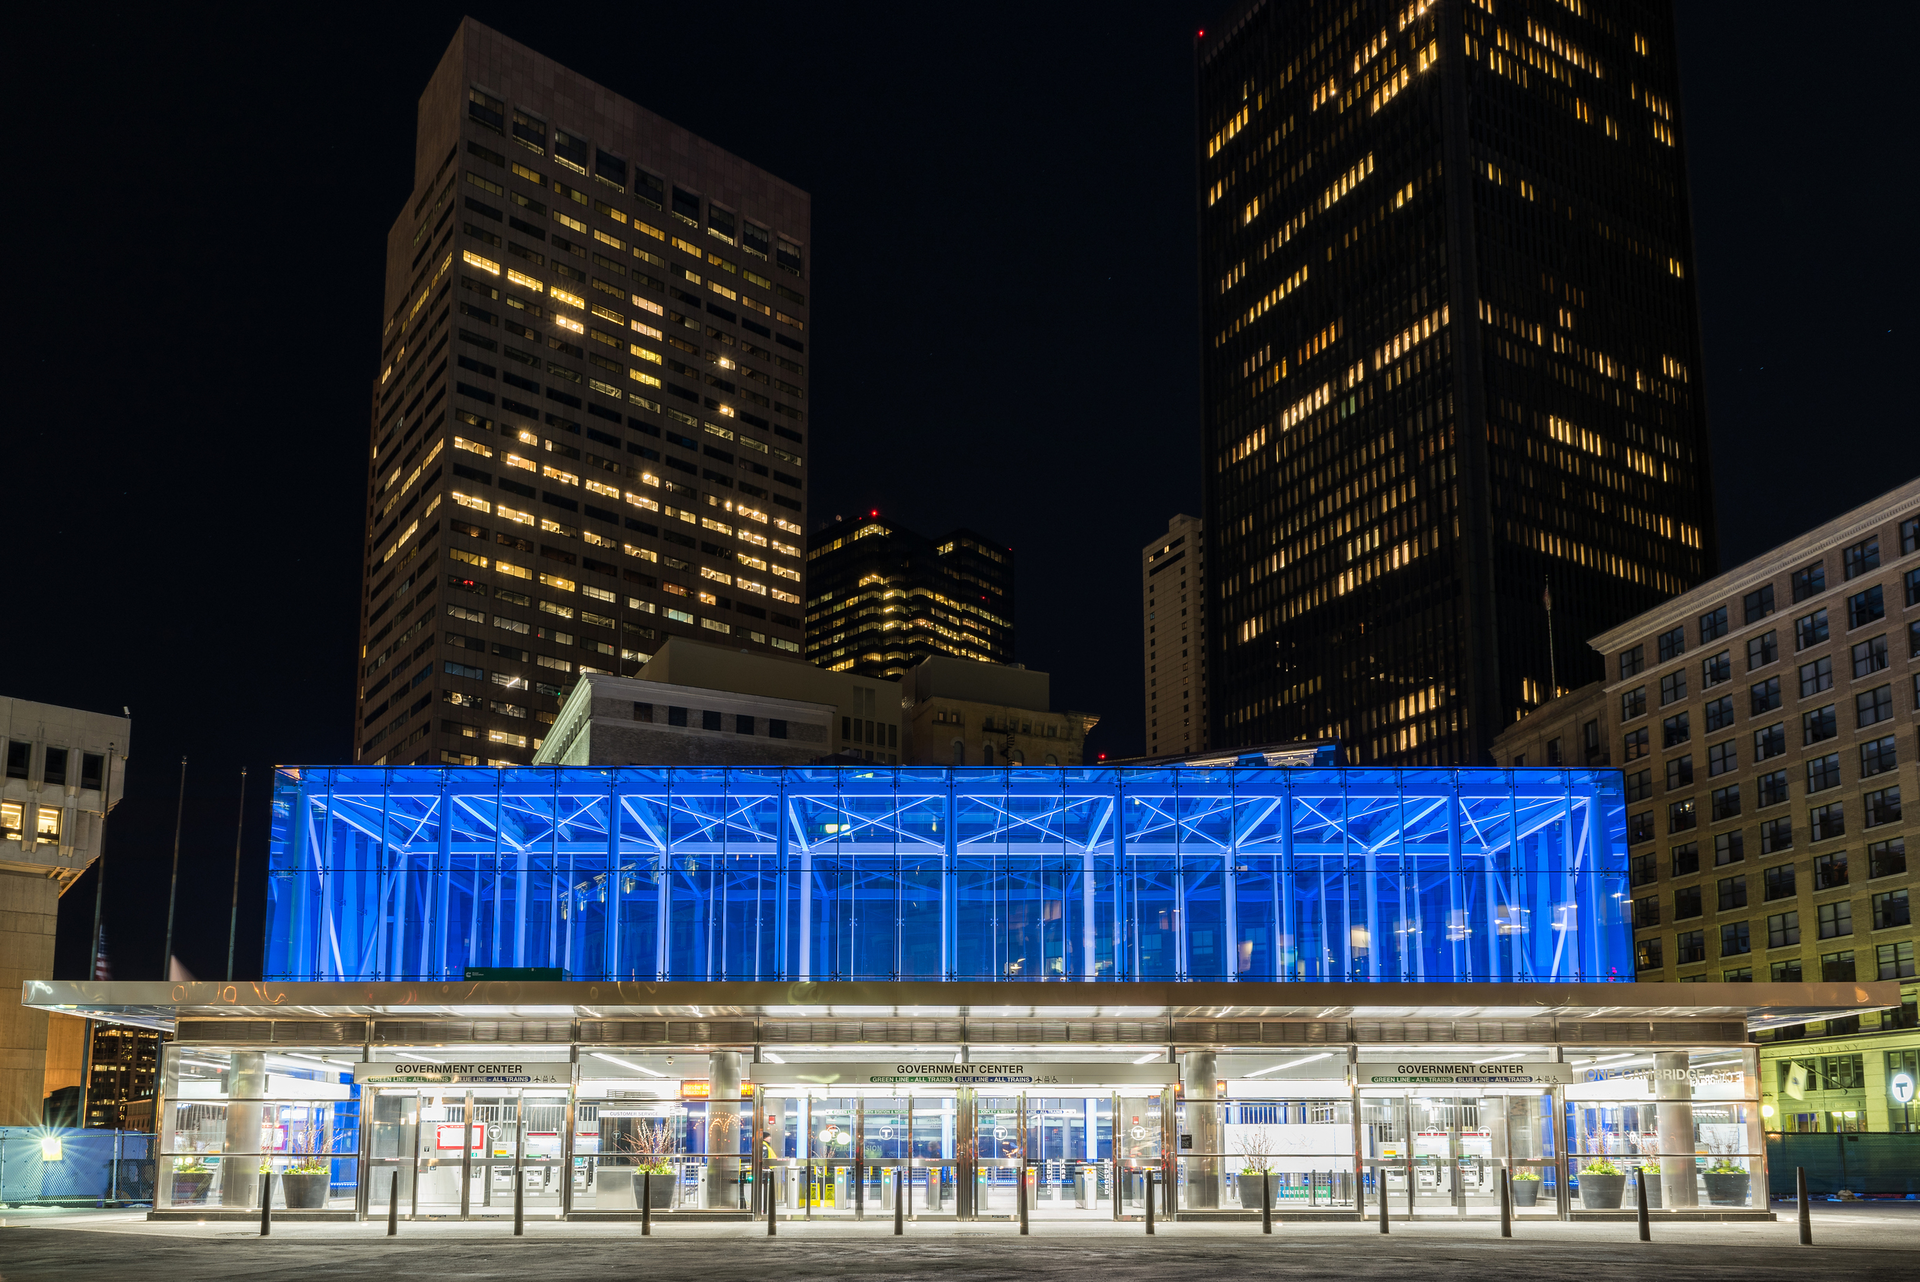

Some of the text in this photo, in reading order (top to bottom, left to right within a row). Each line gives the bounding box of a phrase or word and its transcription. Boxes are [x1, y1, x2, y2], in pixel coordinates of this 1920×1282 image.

[395, 1065, 522, 1073] GOVERNMENT CENTER
[897, 1065, 1024, 1074] GOVERNMENT CENTER
[1398, 1065, 1524, 1074] GOVERNMENT CENTER
[1586, 1069, 1615, 1080] ONE
[1622, 1069, 1705, 1081] CAMBRIDGE
